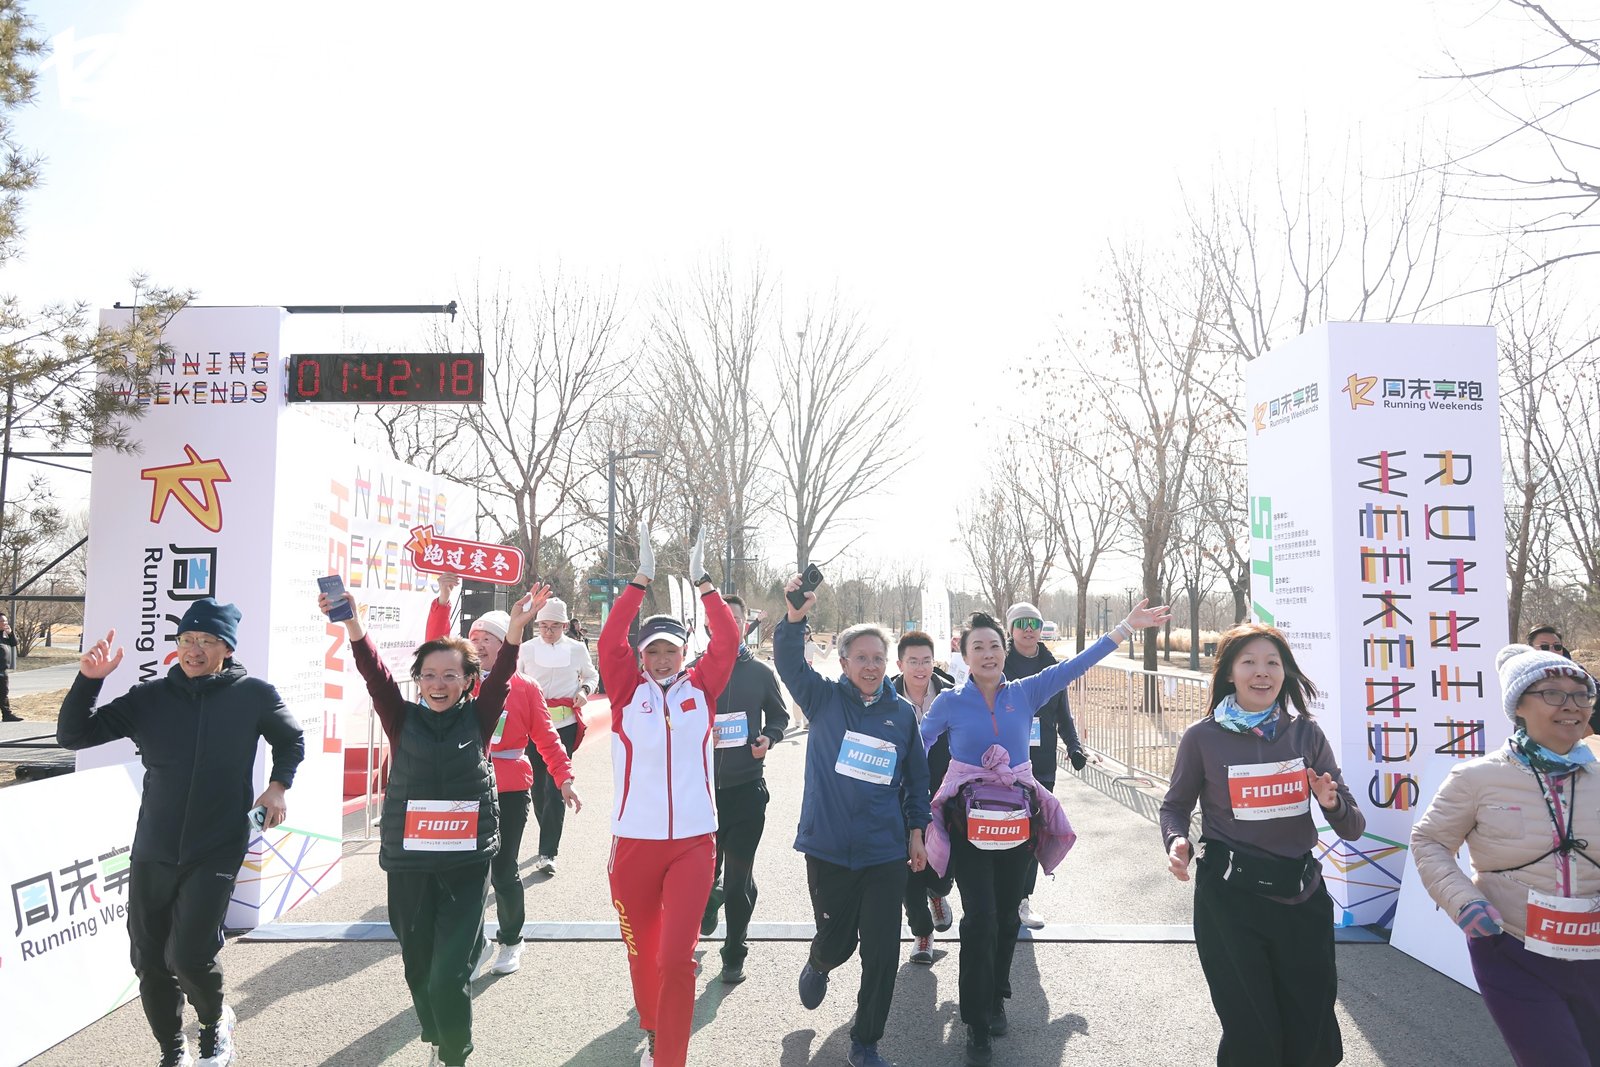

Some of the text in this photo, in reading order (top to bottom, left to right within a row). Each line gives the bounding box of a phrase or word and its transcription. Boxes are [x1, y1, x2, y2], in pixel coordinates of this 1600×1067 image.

[118, 352, 269, 376] NNING
[298, 359, 473, 396] 01:42:18
[111, 381, 269, 405] WEEKENDS
[1268, 382, 1320, 419] 周末享跑
[1382, 379, 1484, 402] 周末享跑
[1384, 400, 1483, 411] Running Weekends
[1269, 404, 1319, 428] Running Weekends
[354, 465, 447, 535] NNING
[423, 543, 510, 576] 跑过寒冬
[136, 547, 164, 652] Running
[322, 479, 350, 754] FINSH
[1424, 450, 1486, 758] RUNNIN
[1357, 450, 1420, 811] WEEKENDS
[847, 749, 891, 768] M10182
[1241, 780, 1303, 799] F10044
[417, 819, 469, 831] F10107
[977, 825, 1021, 835] F10041
[11, 846, 130, 938] 周末享
[20, 916, 98, 961] Running
[614, 899, 638, 956] CHINA
